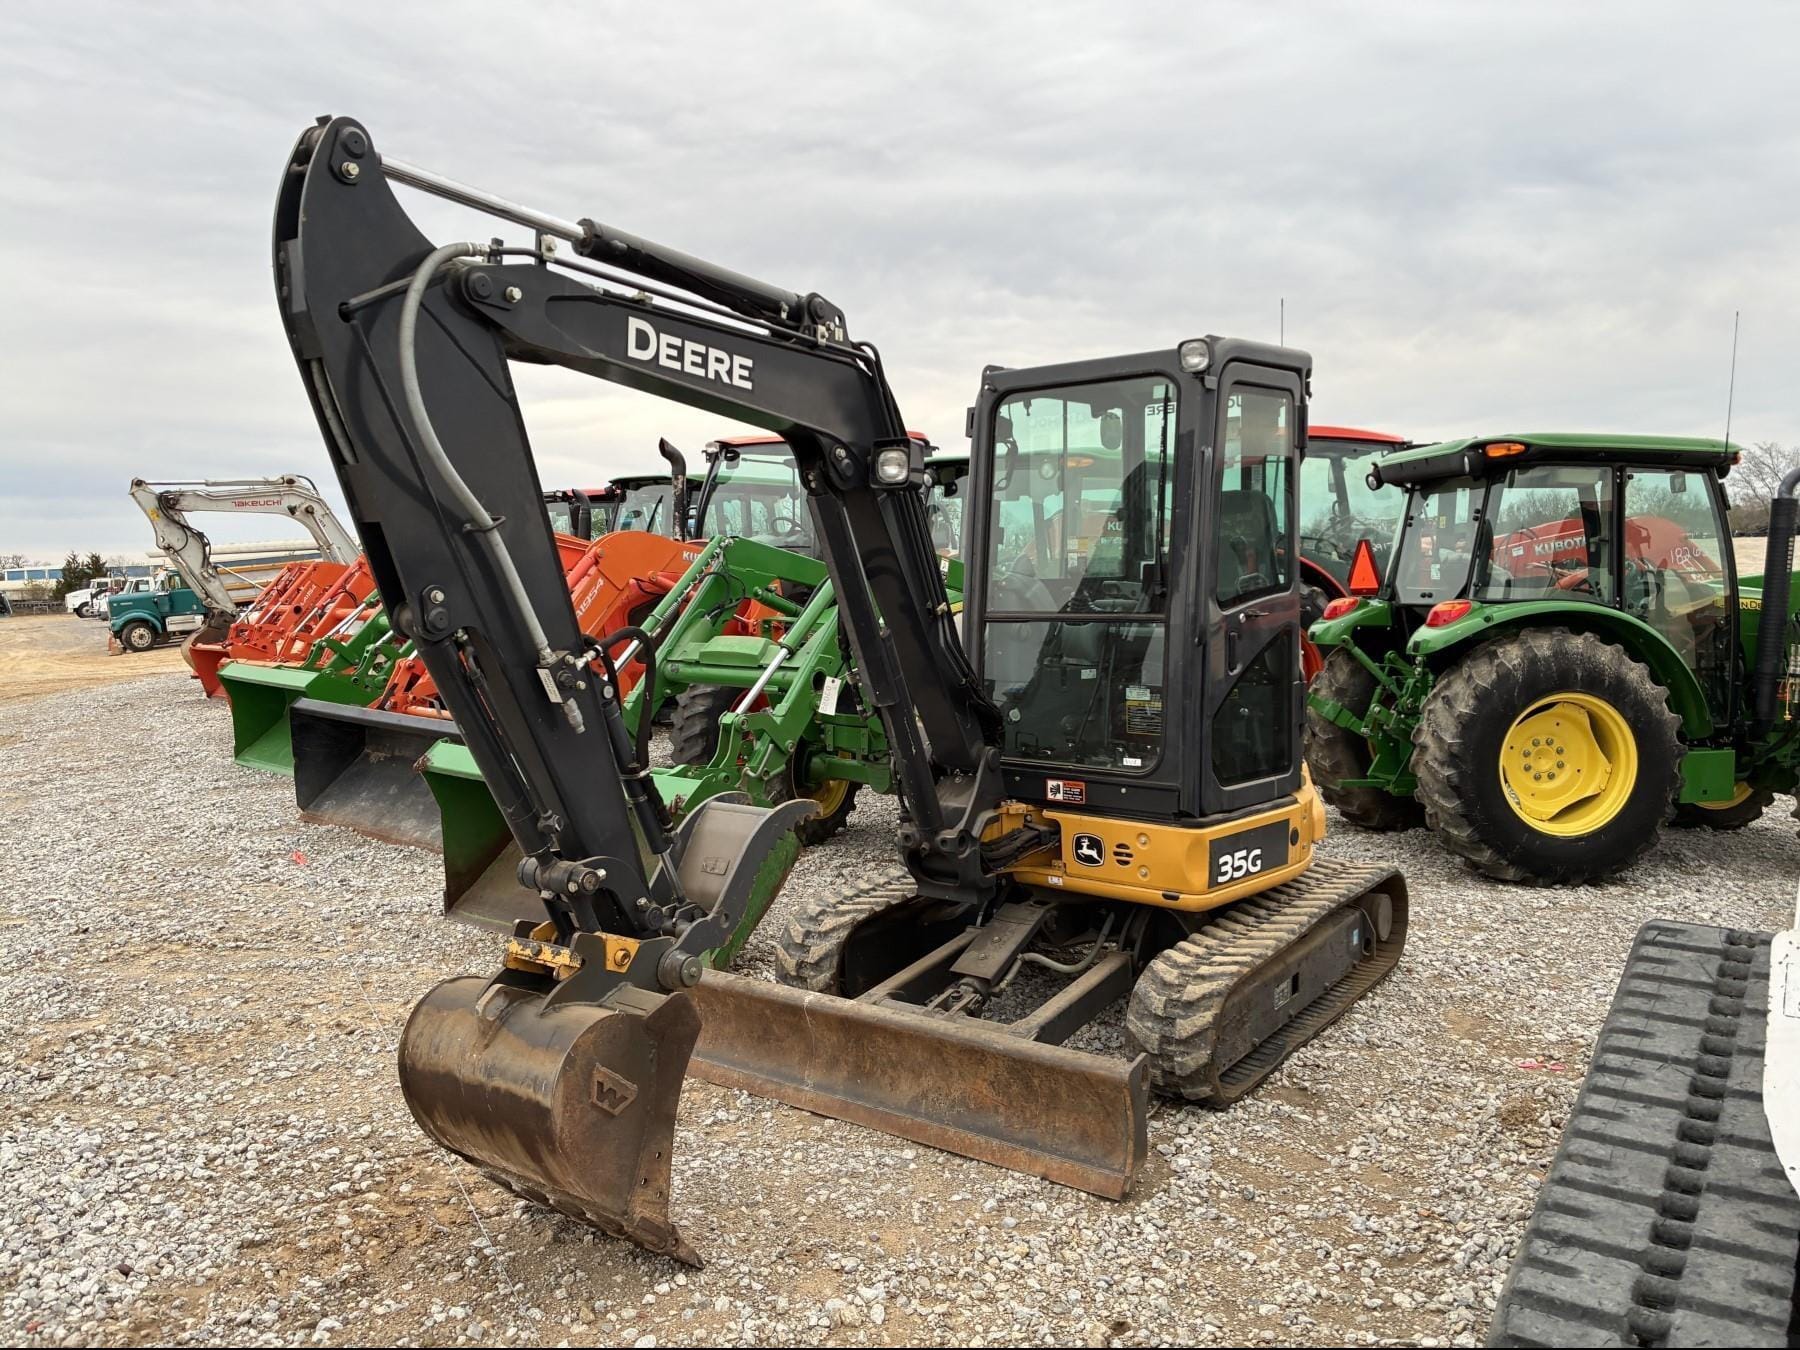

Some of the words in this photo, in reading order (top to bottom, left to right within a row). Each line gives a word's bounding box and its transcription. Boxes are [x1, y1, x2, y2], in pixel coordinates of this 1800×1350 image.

[627, 315, 753, 390] DEERE
[575, 577, 604, 616] A1954
[1217, 848, 1262, 883] 35G
